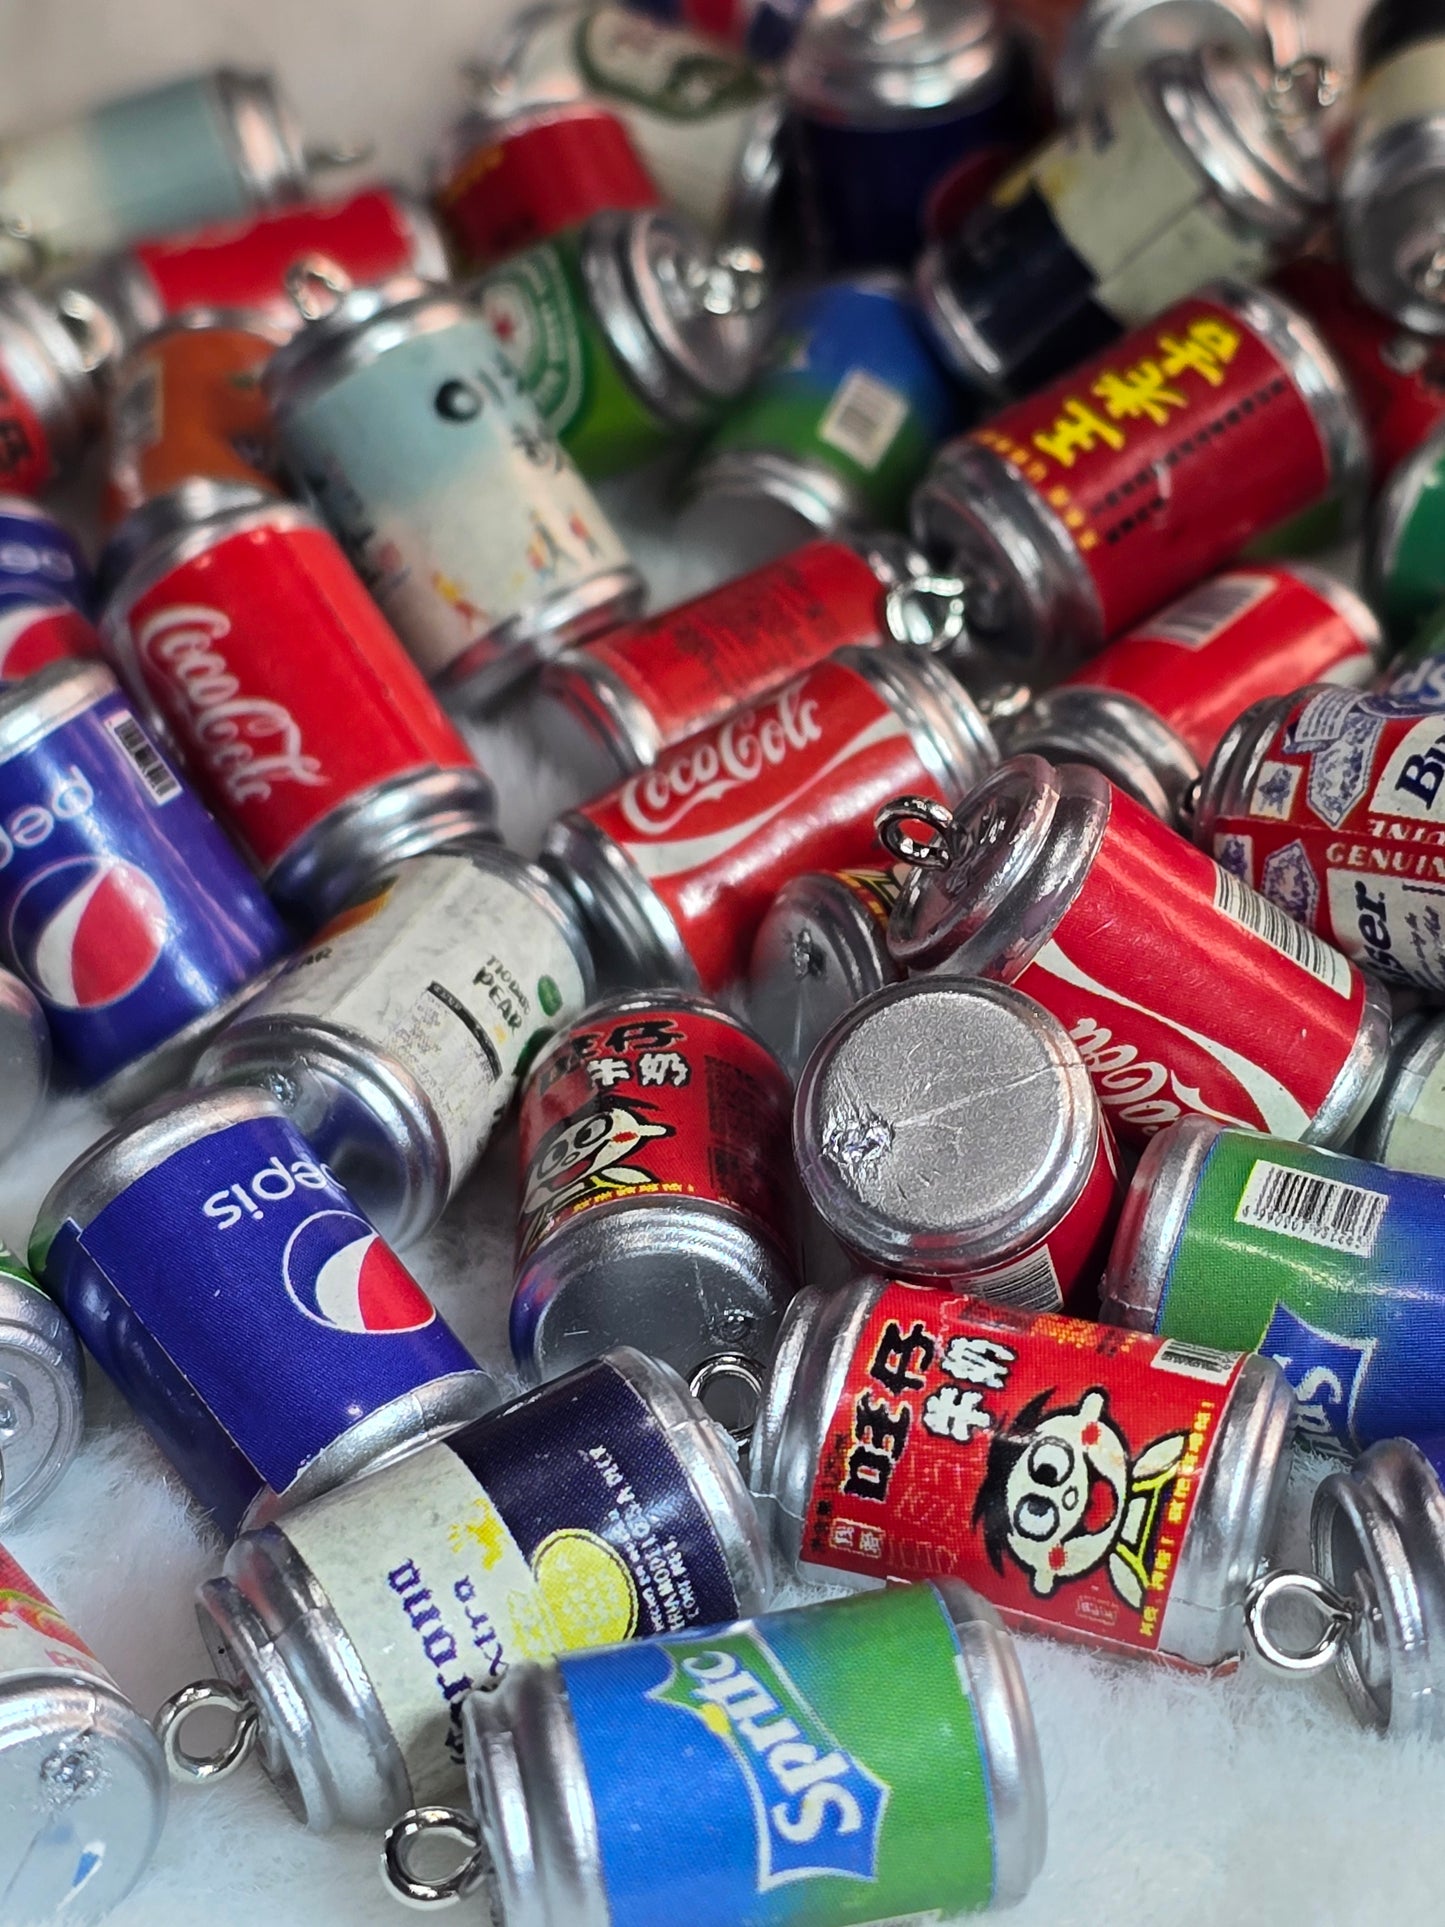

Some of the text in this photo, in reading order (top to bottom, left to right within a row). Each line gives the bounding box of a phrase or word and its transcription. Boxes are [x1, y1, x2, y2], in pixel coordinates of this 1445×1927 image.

[1035, 319, 1242, 466] 王老吉
[472, 966, 524, 1034] PEAR
[587, 1052, 690, 1088] 牛奶
[924, 1336, 1018, 1443] 牛奶
[389, 1559, 472, 1763] rona
[456, 1577, 512, 1677] xtra
